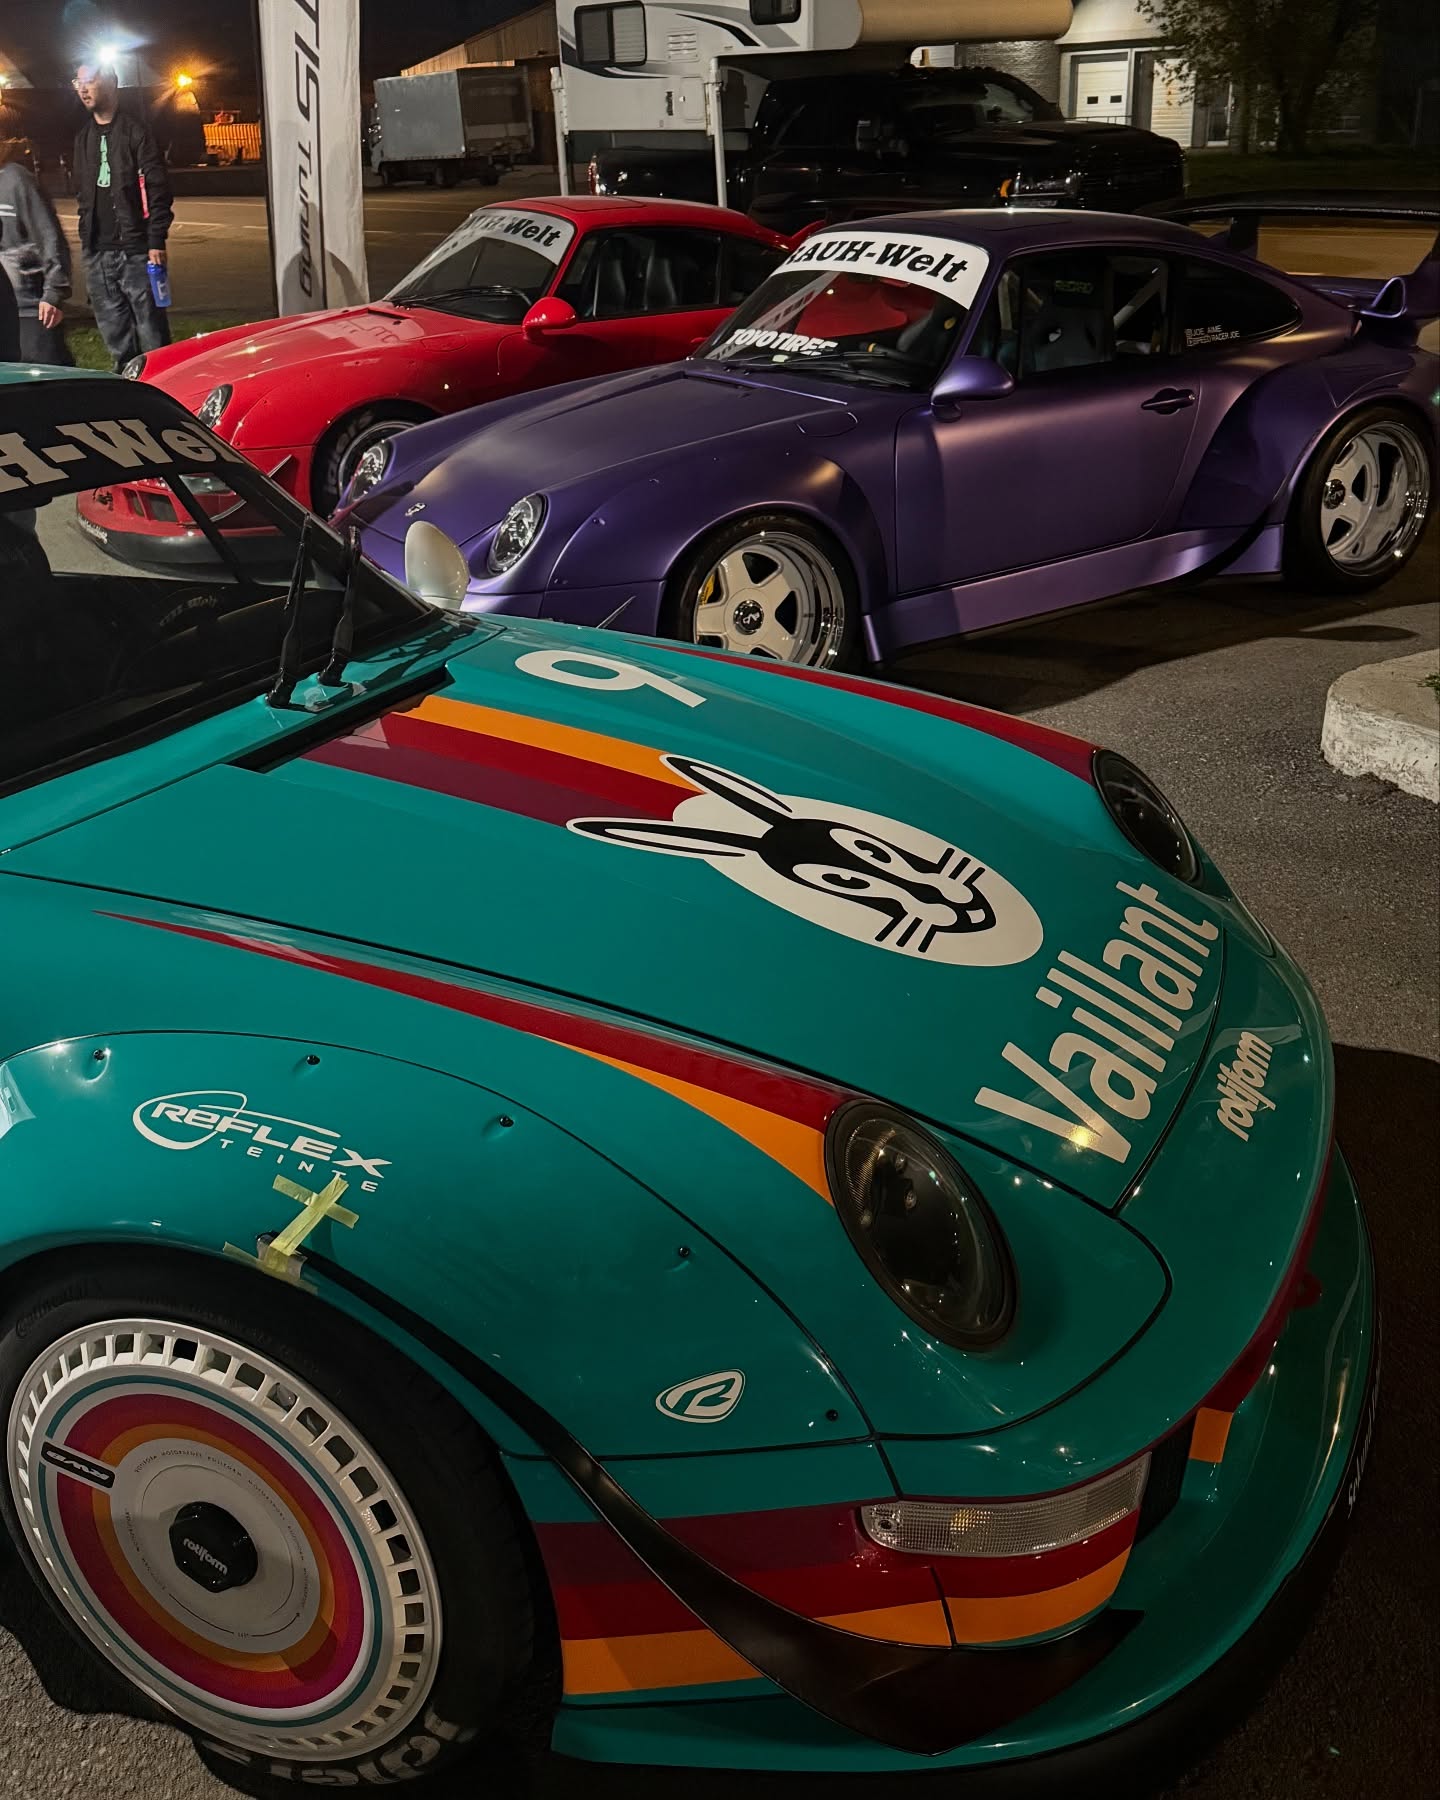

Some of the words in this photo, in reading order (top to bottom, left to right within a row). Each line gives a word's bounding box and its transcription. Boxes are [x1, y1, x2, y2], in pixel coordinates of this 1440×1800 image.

[514, 649, 708, 708] 9
[974, 880, 1220, 1164] Vaillant
[1216, 1031, 1277, 1142] rotiform
[183, 1537, 228, 1577] rotiform
